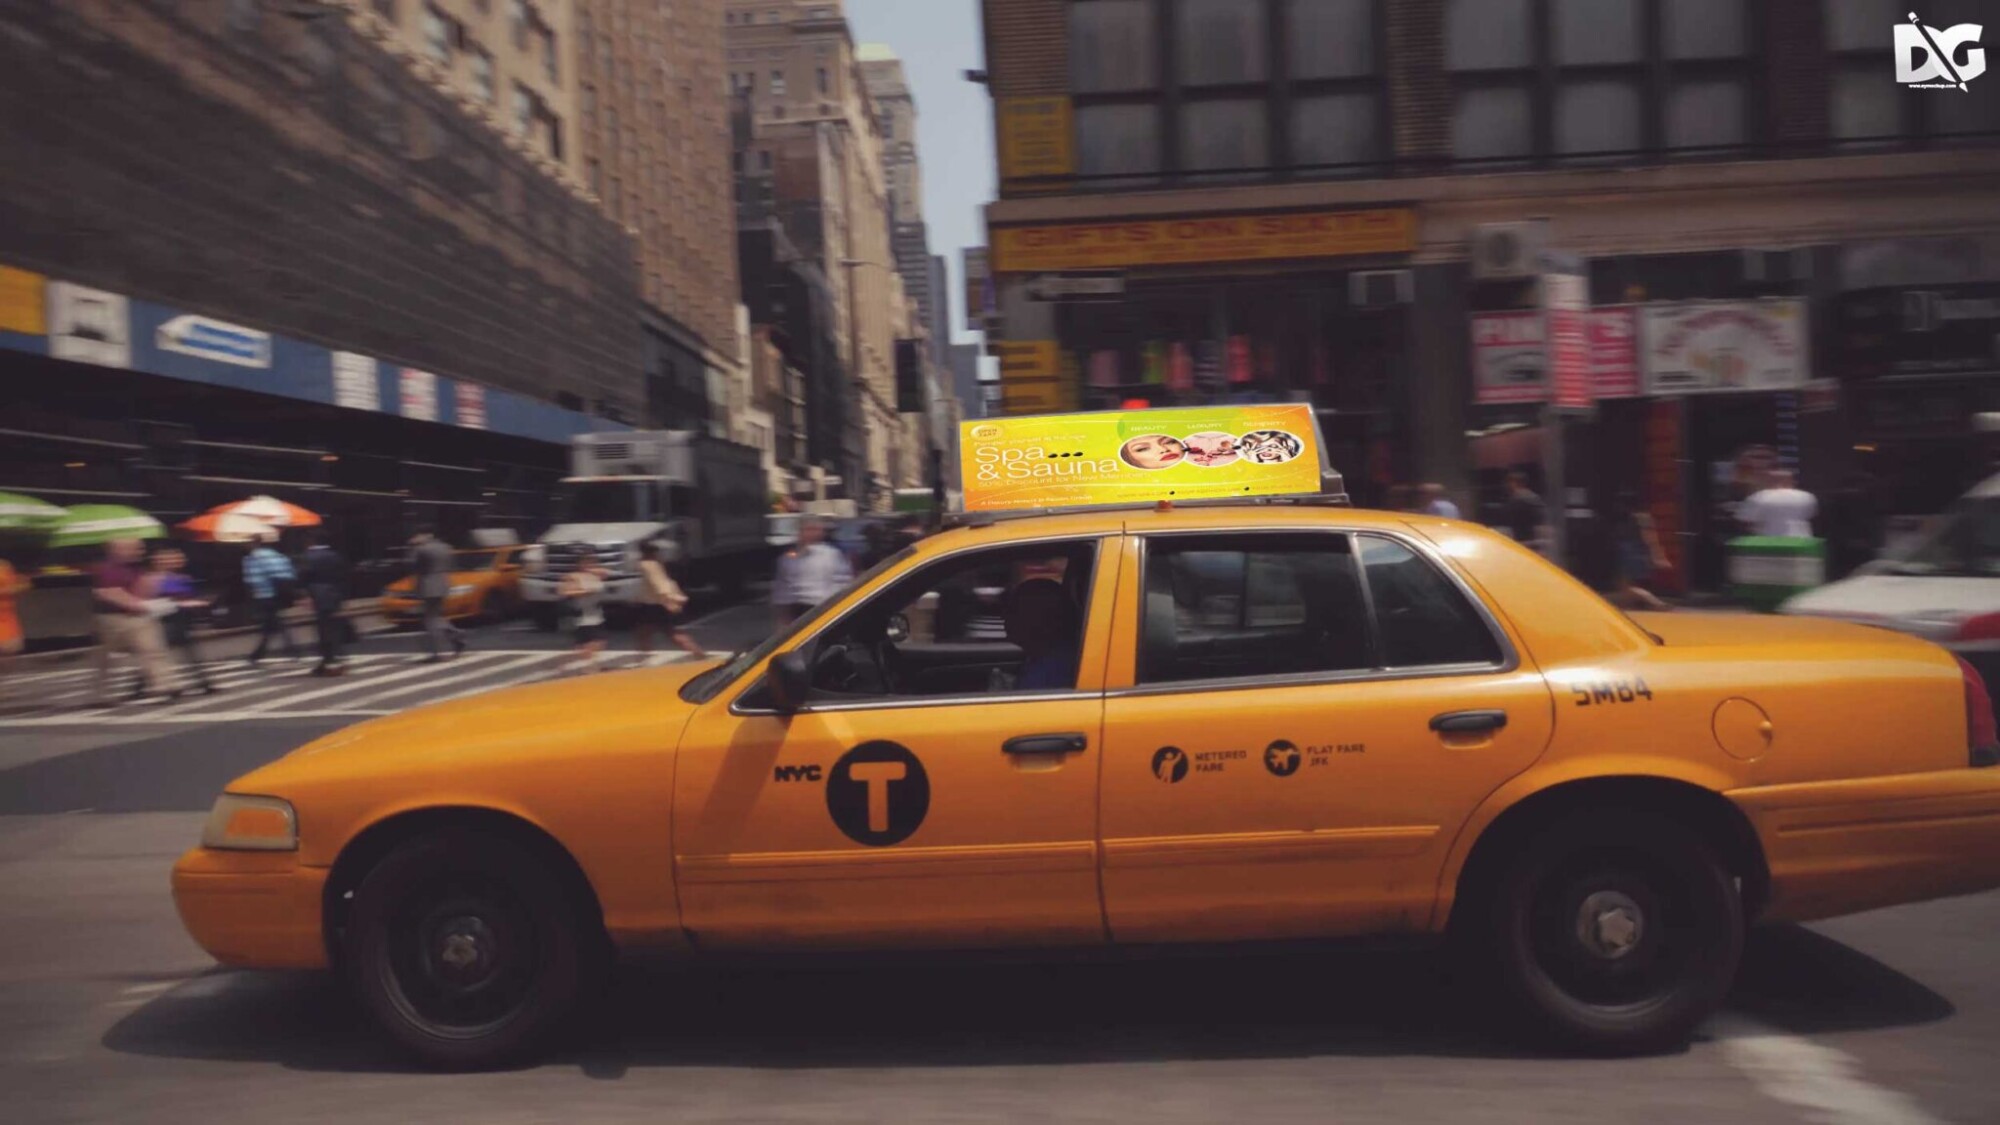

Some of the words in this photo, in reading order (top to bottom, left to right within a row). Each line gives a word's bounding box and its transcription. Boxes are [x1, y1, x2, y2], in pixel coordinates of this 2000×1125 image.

[977, 463, 1000, 481] &
[1006, 458, 1120, 479] Sauna
[1307, 745, 1333, 755] FLAT
[1337, 744, 1365, 753] FARE
[1195, 750, 1247, 761] METERED
[1196, 763, 1224, 772] FARE
[1311, 757, 1329, 767] JFK
[774, 765, 822, 782] NYC
[849, 761, 906, 832] T
